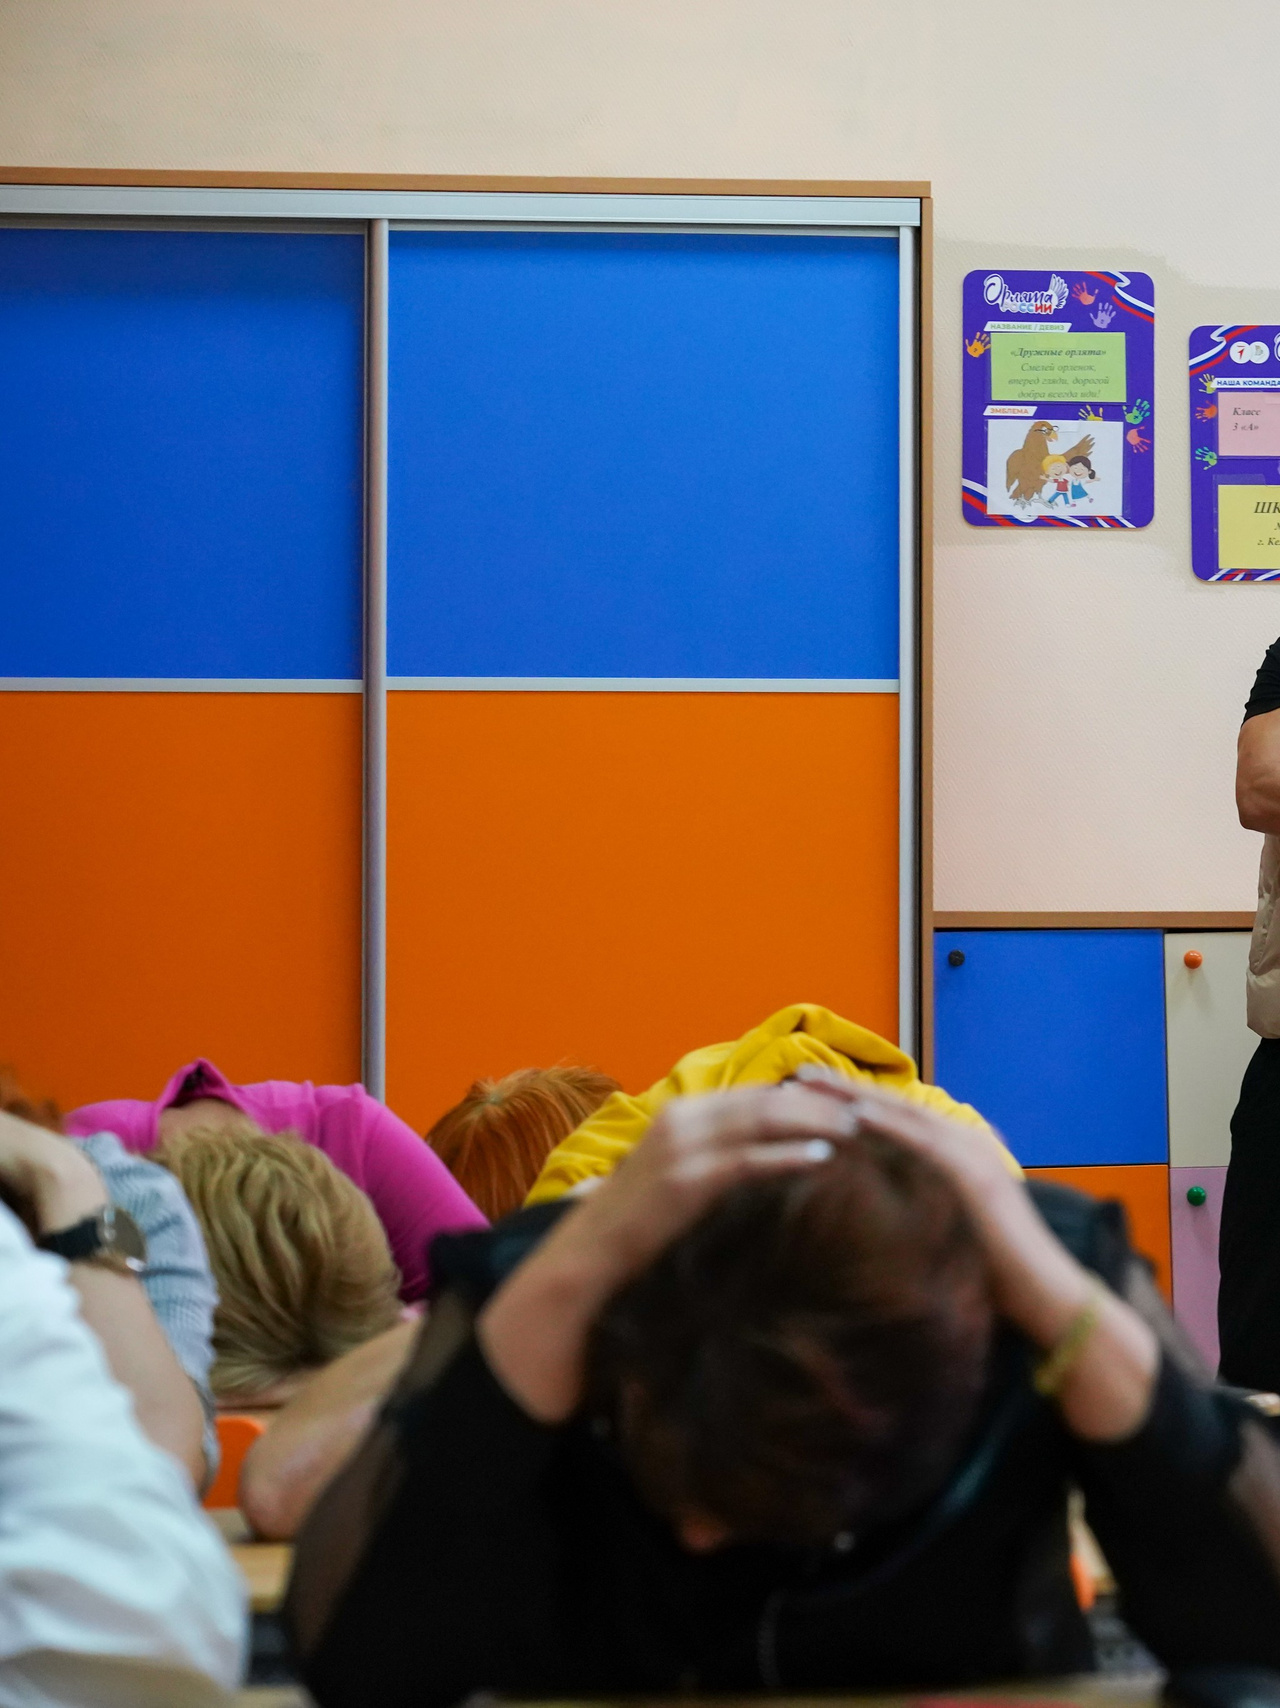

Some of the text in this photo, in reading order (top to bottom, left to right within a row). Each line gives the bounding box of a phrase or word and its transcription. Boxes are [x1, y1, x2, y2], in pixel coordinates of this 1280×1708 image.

[990, 323, 1032, 331] НАЗВАНИЕ
[990, 407, 1029, 415] ЭМБЛЕМА
[1232, 407, 1261, 416] Класс
[1232, 422, 1238, 431] 3
